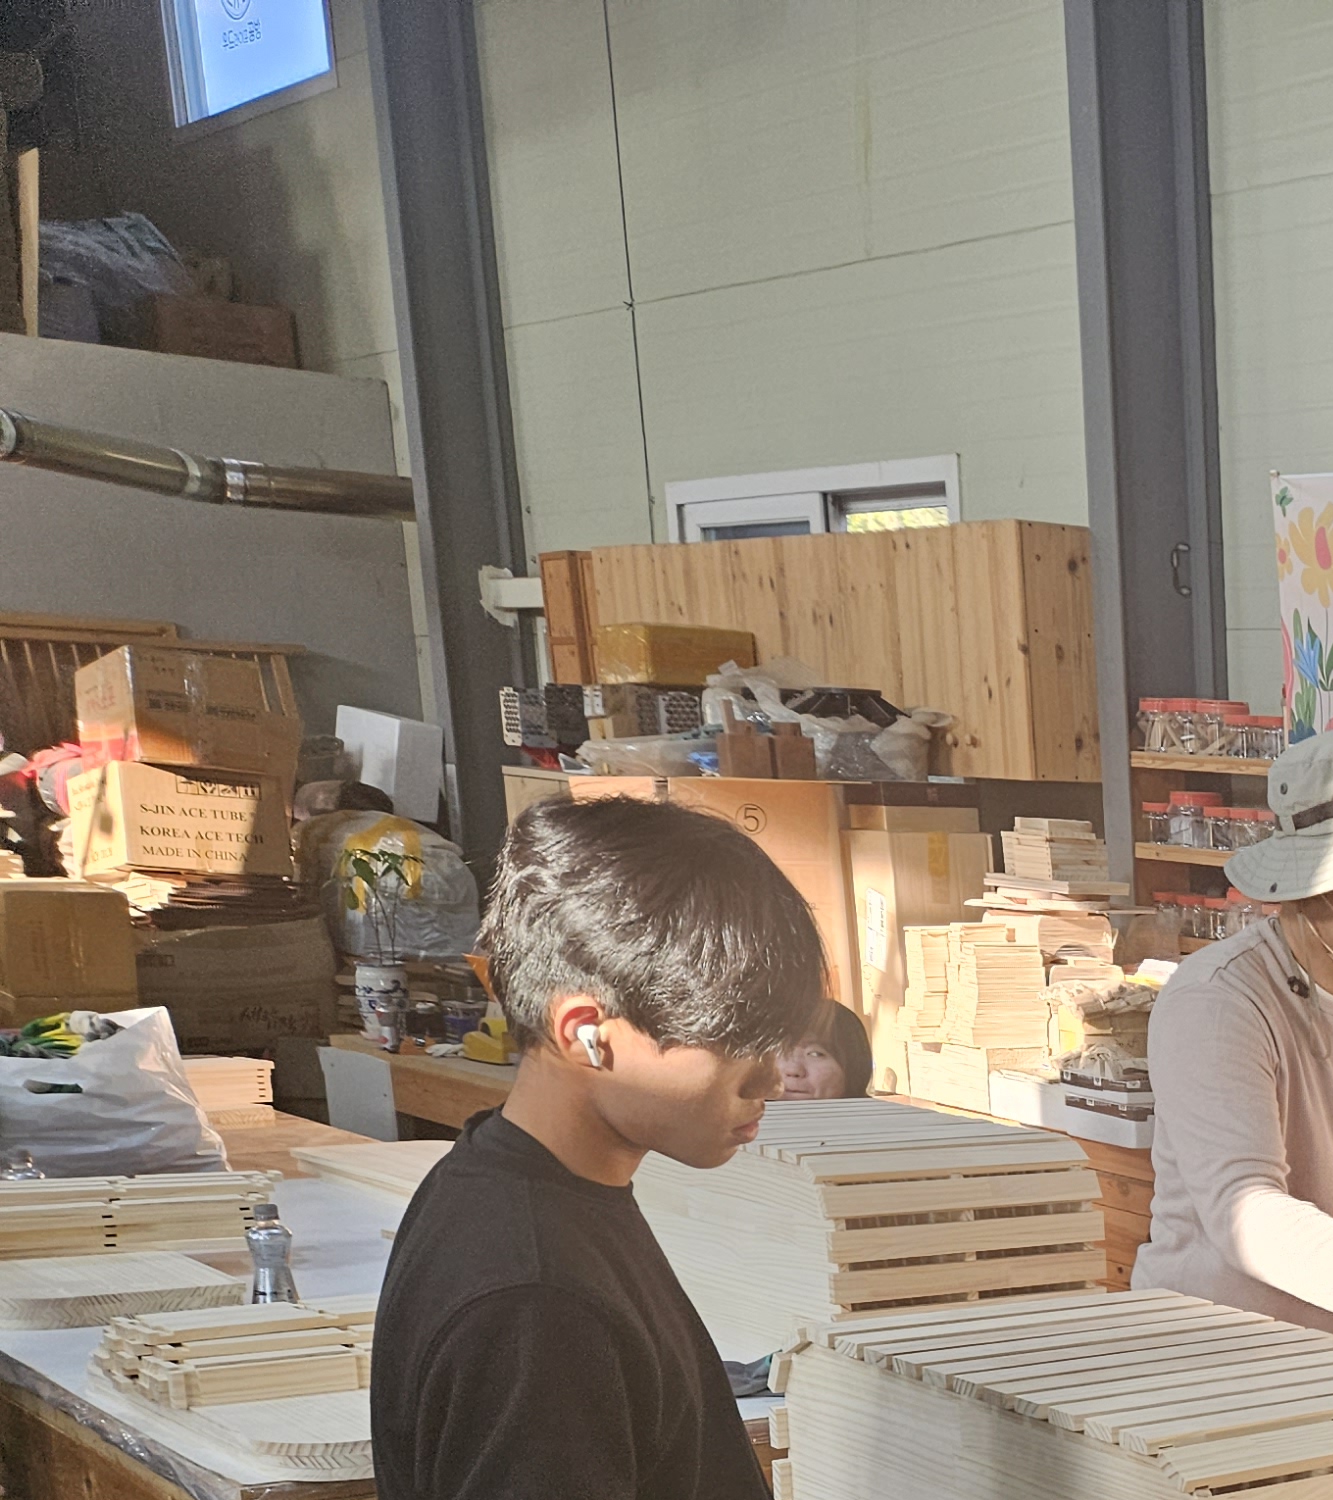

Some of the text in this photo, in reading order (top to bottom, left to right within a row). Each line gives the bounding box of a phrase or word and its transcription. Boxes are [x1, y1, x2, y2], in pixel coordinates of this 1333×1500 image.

[140, 803, 176, 816] S-JIN
[179, 807, 207, 819] ACE
[209, 809, 248, 822] TUBE
[139, 825, 264, 845] KOREA ACE TECH
[142, 845, 249, 862] MADE IN CHINA
